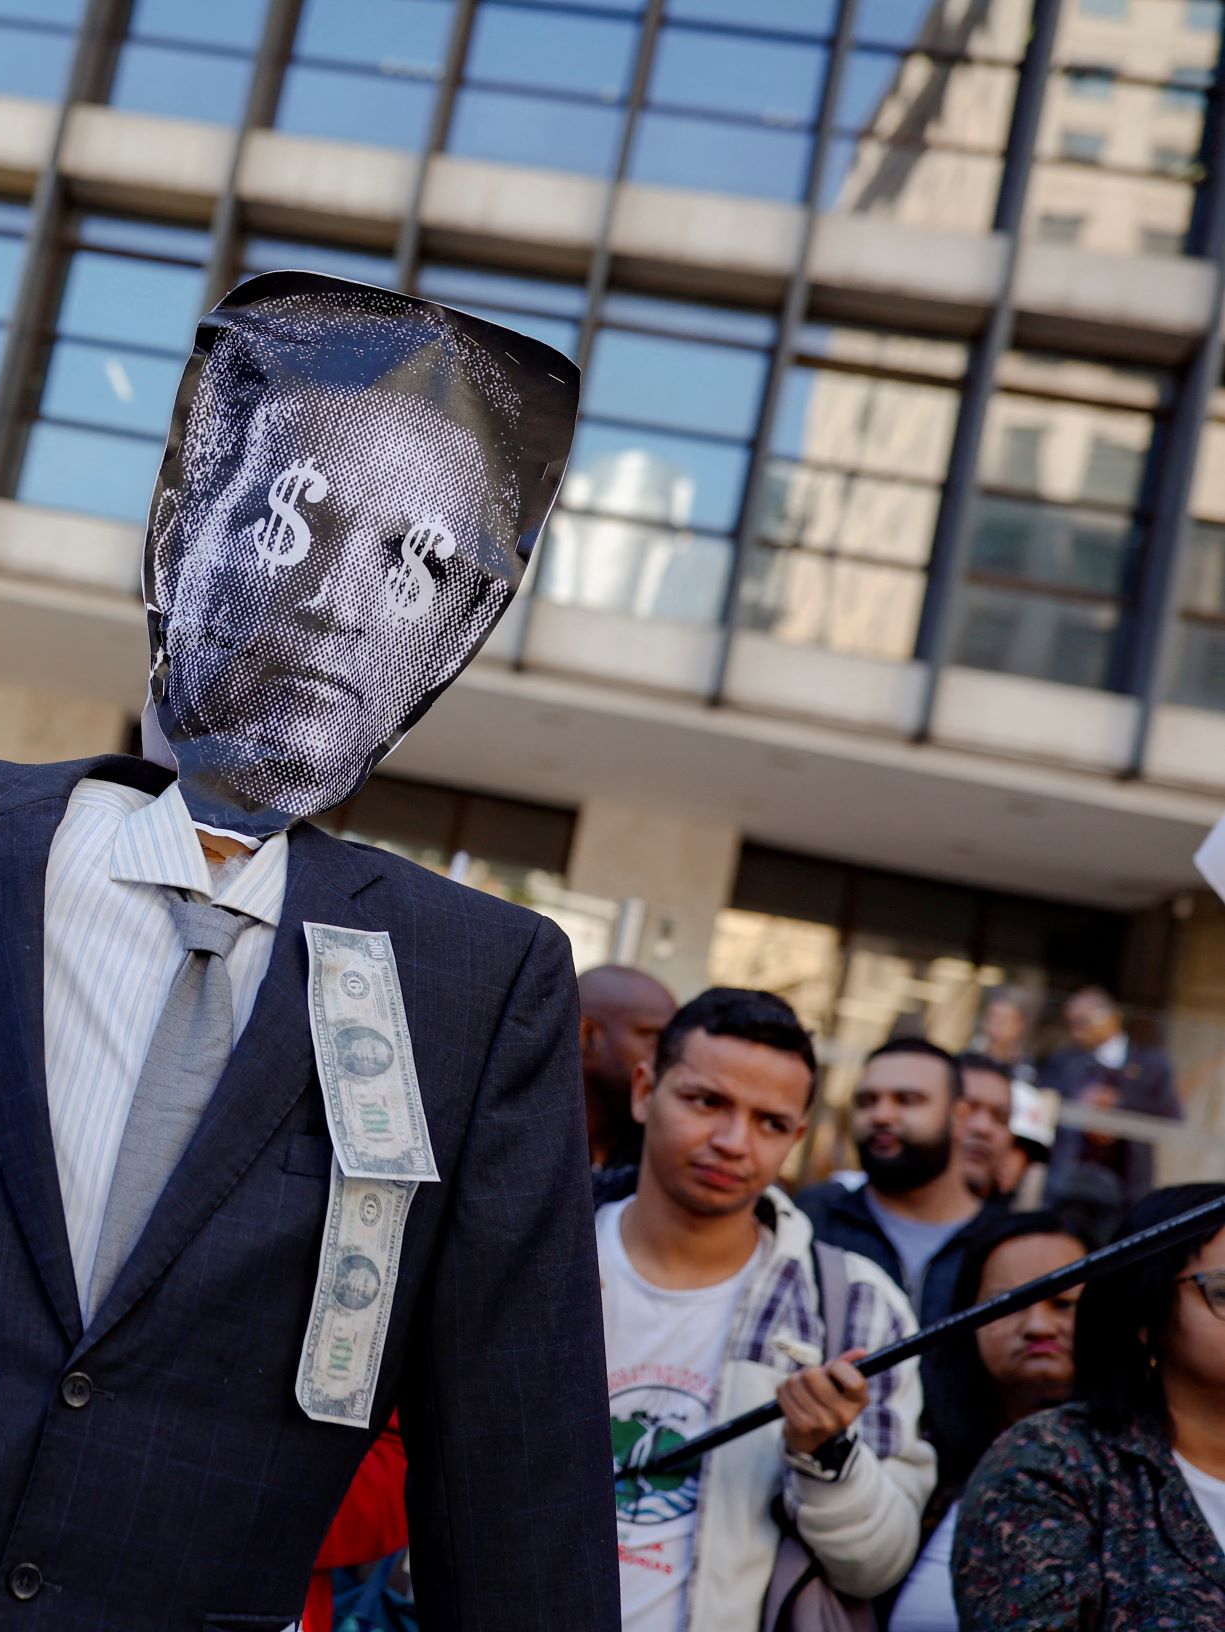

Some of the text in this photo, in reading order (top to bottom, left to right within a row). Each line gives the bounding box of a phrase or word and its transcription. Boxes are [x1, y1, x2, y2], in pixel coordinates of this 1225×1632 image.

[313, 928, 325, 954] 500
[367, 937, 387, 960] 500
[301, 1379, 314, 1408] 500
[352, 1390, 367, 1418] 500
